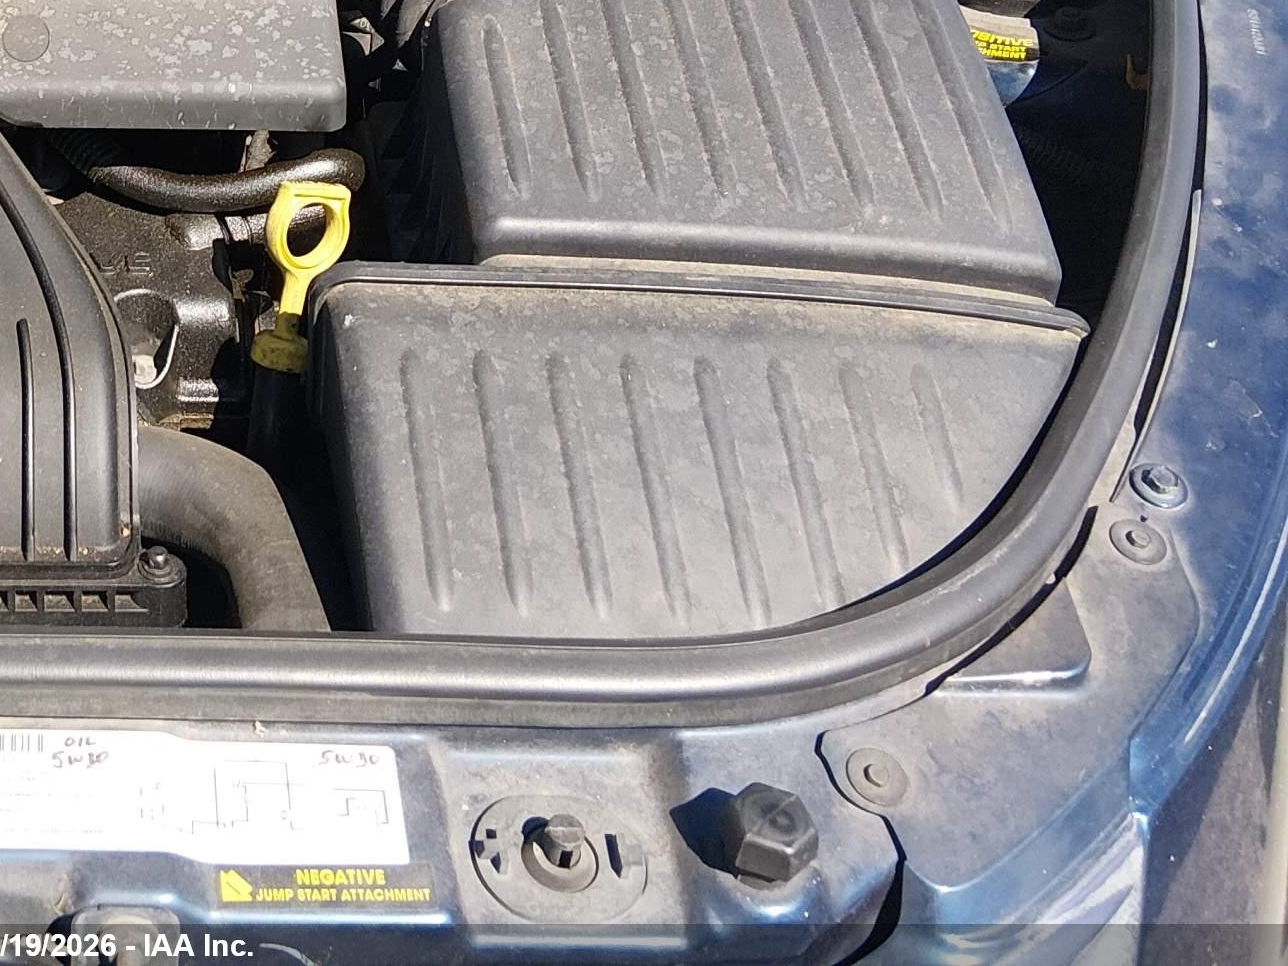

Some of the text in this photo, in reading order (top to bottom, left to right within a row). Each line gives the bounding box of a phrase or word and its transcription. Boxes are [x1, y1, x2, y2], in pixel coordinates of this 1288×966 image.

[295, 868, 386, 885] NEGATIVE
[256, 888, 431, 902] JUMP START ATTACHMENT
